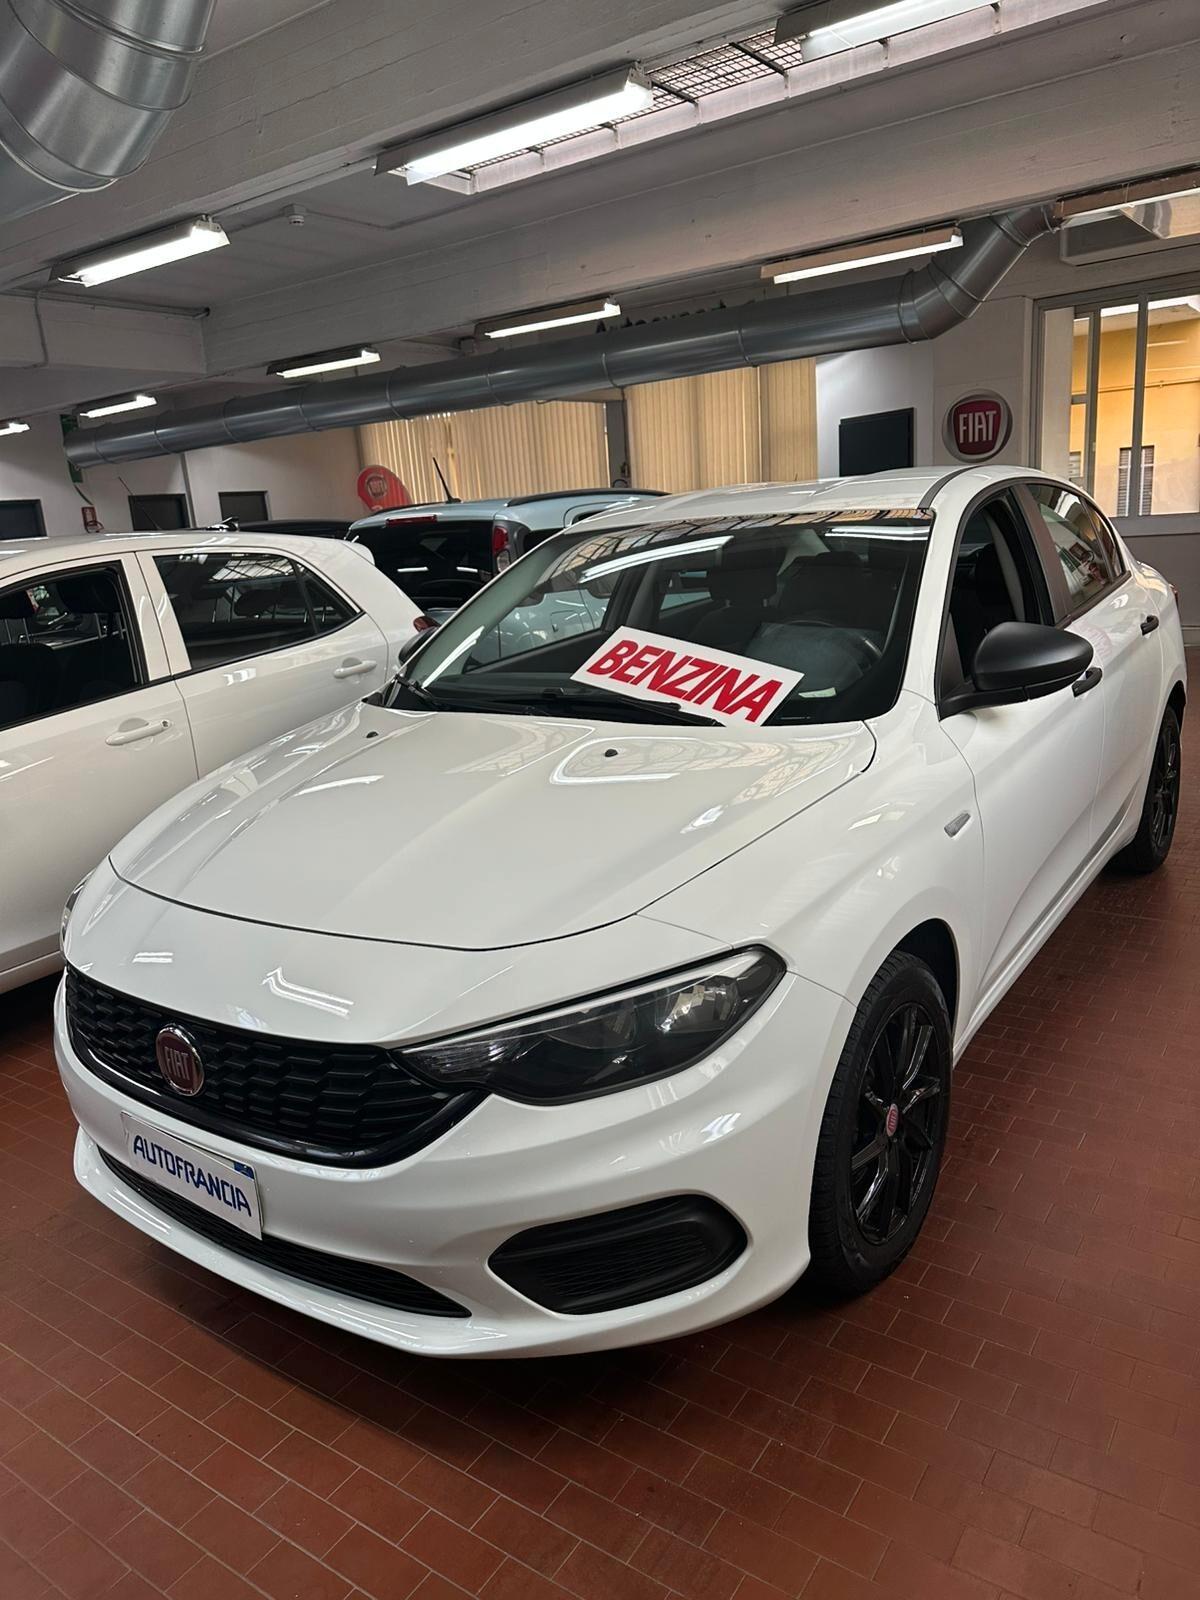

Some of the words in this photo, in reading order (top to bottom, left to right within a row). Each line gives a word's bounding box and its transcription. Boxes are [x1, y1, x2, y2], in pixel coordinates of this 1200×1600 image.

[959, 410, 997, 444] FIAT
[586, 640, 783, 723] BENZINA
[164, 1046, 191, 1081] FIAT
[133, 1134, 252, 1217] AUTOFRANCIA
